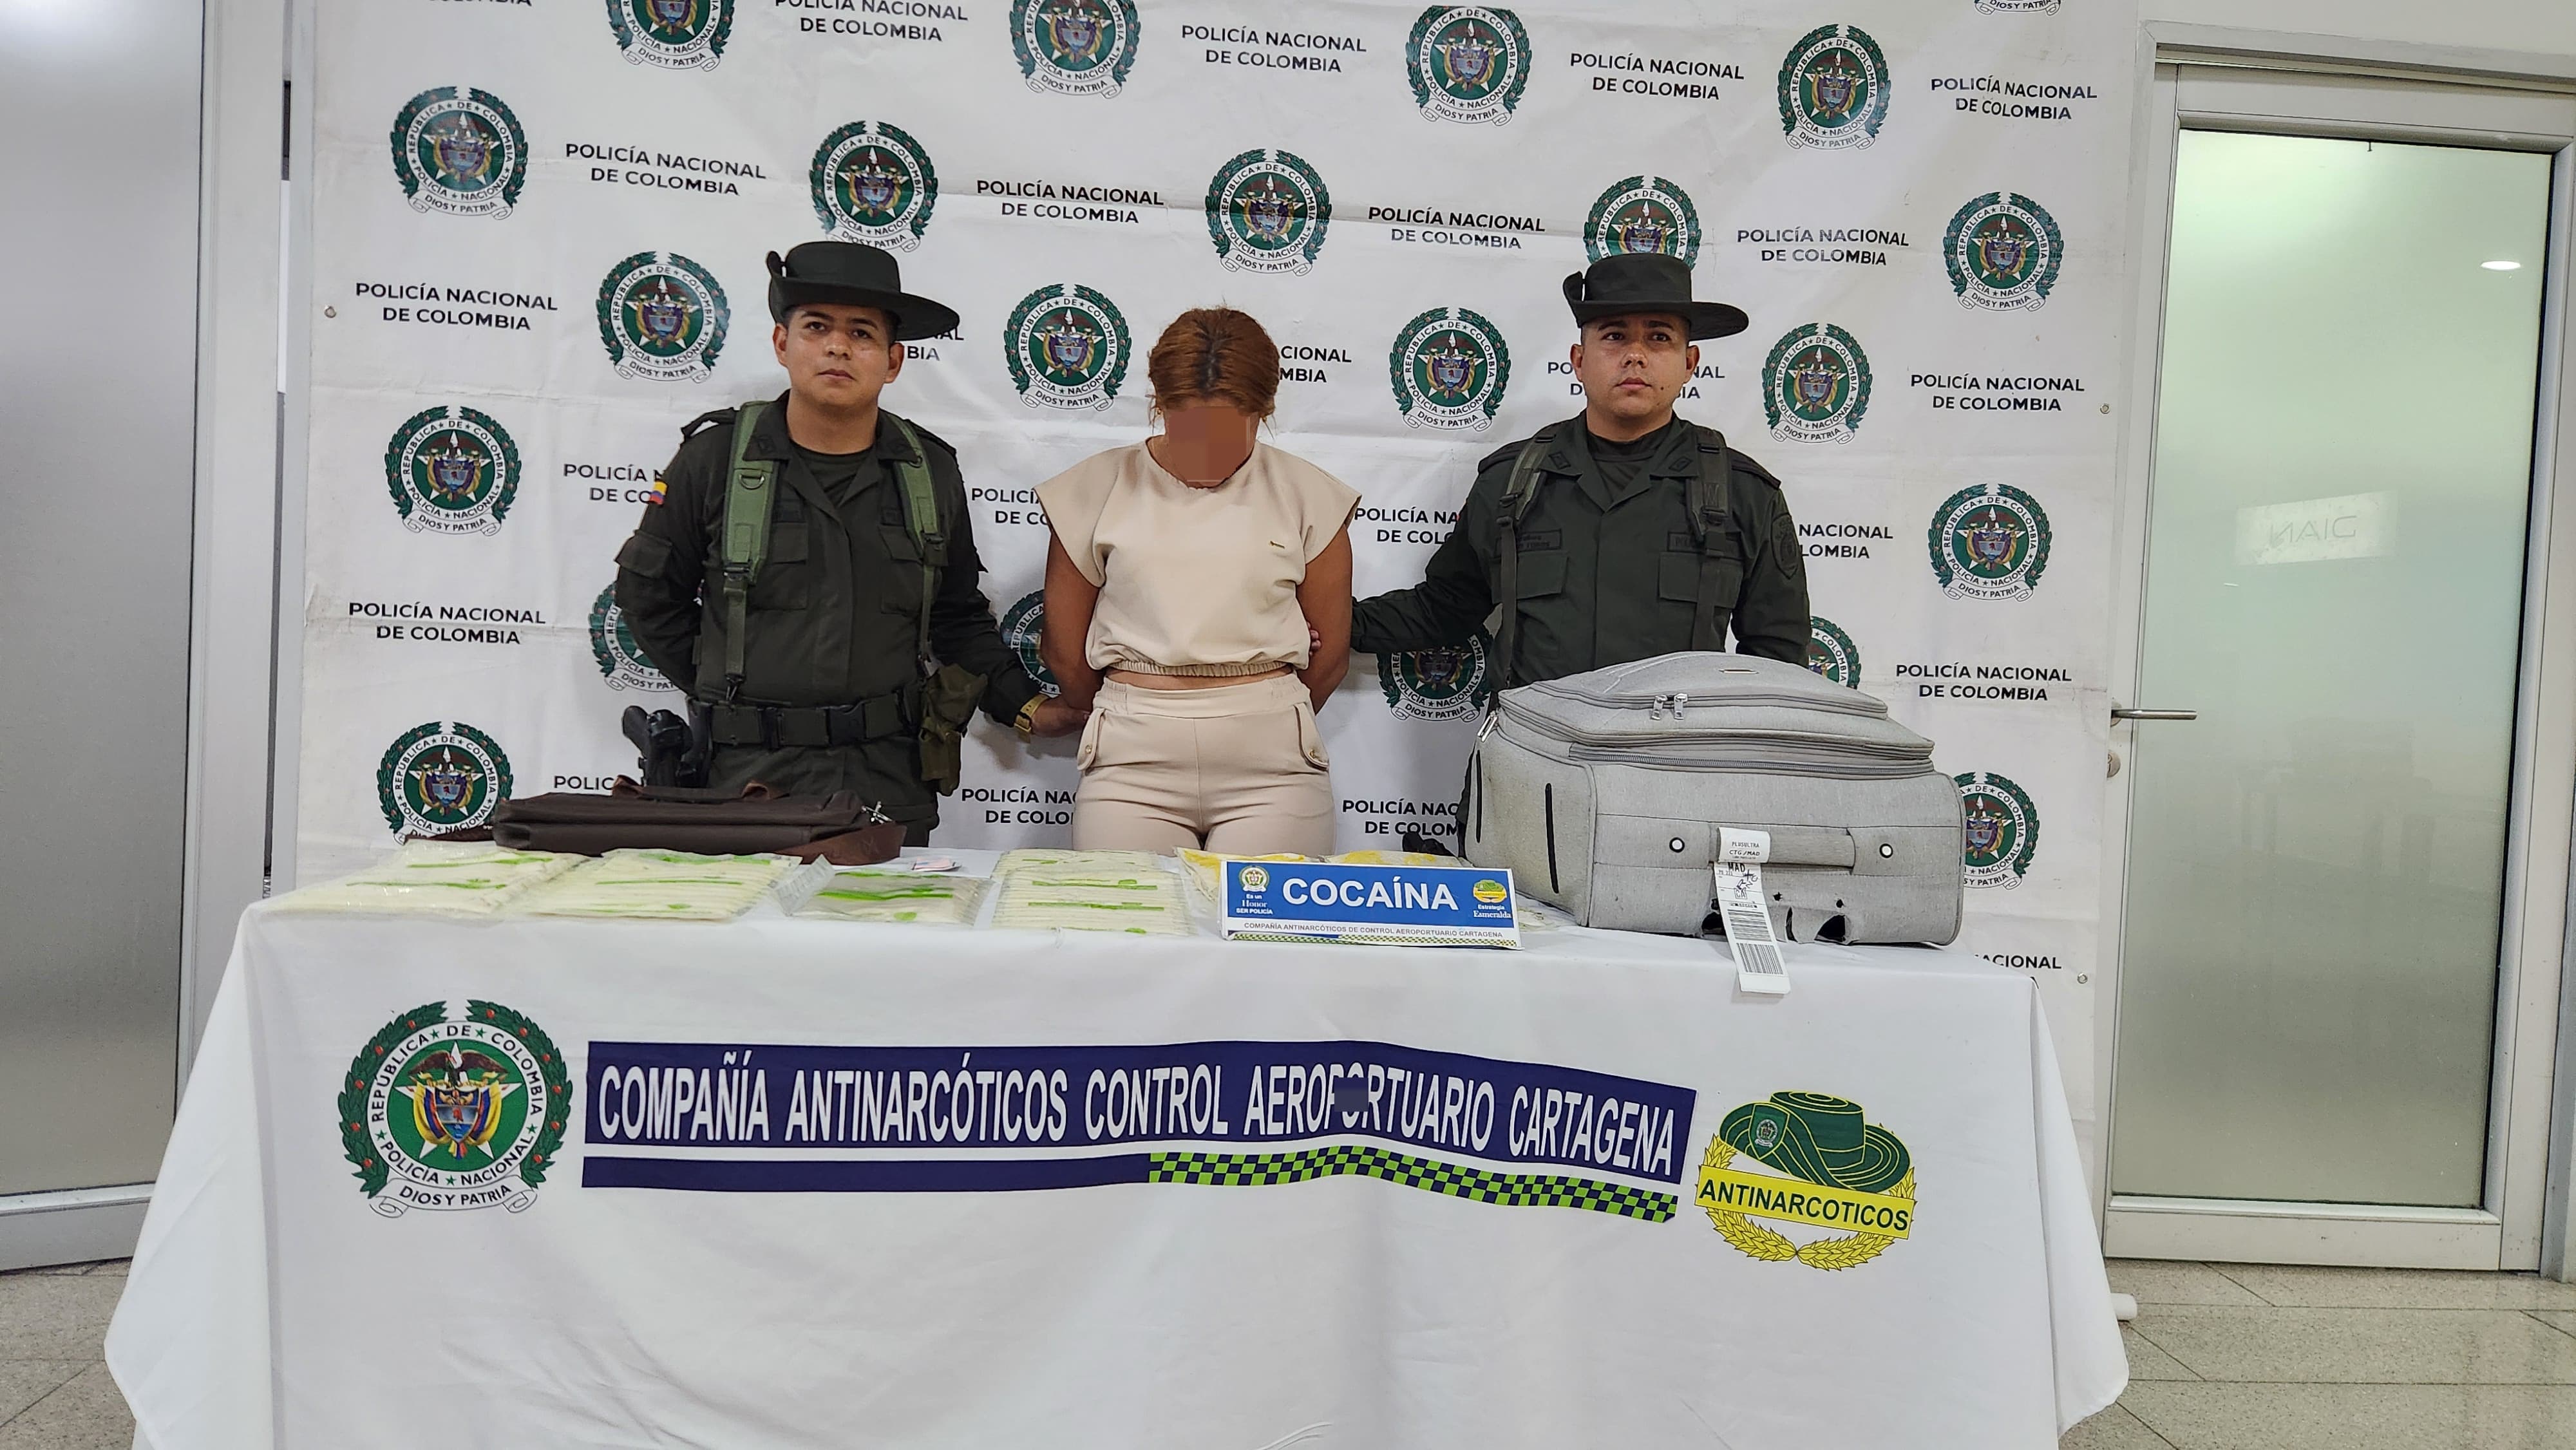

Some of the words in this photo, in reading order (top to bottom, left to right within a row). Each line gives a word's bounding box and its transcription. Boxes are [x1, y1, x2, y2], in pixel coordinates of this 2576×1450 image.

[862, 0, 968, 21] NACIONAL
[800, 17, 826, 32] DE
[833, 19, 942, 41] COLOMBIA
[1182, 25, 1260, 44] POLICÍA
[1266, 32, 1367, 52] NACIONAL
[1489, 17, 1515, 69] COLOMBIA
[1206, 50, 1231, 64] DE
[1238, 52, 1341, 72] COLOMBIA
[1571, 53, 1644, 71] POLICÍA
[1650, 59, 1744, 79] NACIONAL
[1467, 80, 1510, 108] NACIONAL
[1593, 77, 1617, 91] DE
[1623, 79, 1719, 100] COLOMBIA
[1931, 75, 2000, 93] POLICÍA
[2005, 82, 2097, 99] NACIONAL
[1466, 108, 1499, 120] PATRIA
[1956, 98, 1978, 112] DE
[1982, 100, 2071, 119] COLOMBIA
[457, 102, 472, 110] DE
[484, 109, 513, 162] COLOMBIA
[566, 144, 650, 165] POLICÍA
[657, 153, 766, 179] NACIONAL
[461, 174, 509, 200] NACIONAL
[591, 168, 618, 182] DE
[625, 170, 740, 196] COLOMBIA
[976, 180, 1054, 199] POLICÍA
[1062, 186, 1164, 205] NACIONAL
[460, 202, 497, 212] PATRIA
[1002, 203, 1027, 216] DE
[1034, 204, 1139, 223] COLOMBIA
[1368, 207, 1444, 225] POLICÍA
[1448, 212, 1546, 232] NACIONAL
[1392, 229, 1416, 241] DE
[1422, 230, 1521, 249] COLOMBIA
[1738, 227, 1814, 242] POLICÍA
[1820, 229, 1909, 246] NACIONAL
[2020, 212, 2047, 259] COLOMBIA
[1761, 250, 1786, 261] DE
[1792, 249, 1886, 265] COLOMBIA
[2000, 269, 2043, 297] NACIONAL
[356, 283, 440, 301] POLICÍA
[447, 288, 558, 310] NACIONAL
[1999, 296, 2031, 308] PATRIA
[383, 307, 410, 321] DE
[417, 309, 531, 330] COLOMBIA
[1281, 346, 1352, 362] CIONAL
[1470, 328, 1495, 377] COLOMBIA
[1280, 368, 1327, 382] MBIA
[1911, 373, 1980, 390] POLICÍA
[1987, 377, 2085, 391] NACIONAL
[1449, 389, 1490, 415] NACIONAL
[1933, 395, 1955, 409] DE
[1960, 397, 2061, 411] COLOMBIA
[1448, 414, 1479, 427] PATRIA
[473, 428, 503, 479] COLOMBIA
[564, 464, 648, 482] POLICÍA
[453, 491, 499, 518] NACIONAL
[590, 487, 618, 502] DE
[453, 518, 486, 531] PATRIA
[996, 511, 1020, 524] DE
[1354, 507, 1428, 523] POLICÍA
[1377, 529, 1401, 542] DE
[1799, 524, 1893, 539] NACIONAL
[2011, 502, 2036, 549] COLOMBIA
[1801, 544, 1870, 559] LOMBIA
[1991, 560, 2032, 587] NACIONAL
[1990, 585, 2020, 598] PATRIA
[349, 601, 433, 619] POLICÍA
[440, 607, 545, 624] NACIONAL
[377, 625, 404, 639] DE
[411, 626, 520, 645] COLOMBIA
[1897, 662, 1971, 678] POLICÍA
[1977, 666, 2072, 681] NACIONAL
[1919, 684, 1944, 697] DE
[1951, 685, 2047, 701] COLOMBIA
[554, 776, 614, 790] POLIC
[962, 786, 1039, 803] POLICÍA
[1343, 798, 1416, 815] POLICÍA
[985, 810, 1010, 823] DE
[1017, 811, 1073, 825] COLO
[1365, 822, 1389, 834] DE
[1395, 822, 1458, 836] COLOM
[1728, 862, 1745, 872] MAD
[1283, 876, 1459, 910] COCAÍNA
[1473, 910, 1511, 919] Esmeralda
[1283, 924, 1346, 932] ANTINARCÓTICOS
[1396, 928, 1457, 937] AEROPORTUARIO
[1975, 955, 2061, 969] CIONAL
[446, 1025, 471, 1037] DE
[491, 1033, 544, 1116] COLOMBIA
[598, 1050, 770, 1141] COMPAÑÍA
[785, 1053, 1068, 1142] ANTINARCÓTICOS
[1085, 1065, 1229, 1140] CONTROL
[1509, 1086, 1675, 1176] CARTAGENA
[460, 1135, 533, 1186] NACIONAL
[460, 1185, 512, 1205] PATRIA
[1699, 1179, 1909, 1231] ANTINARCOTICOS
